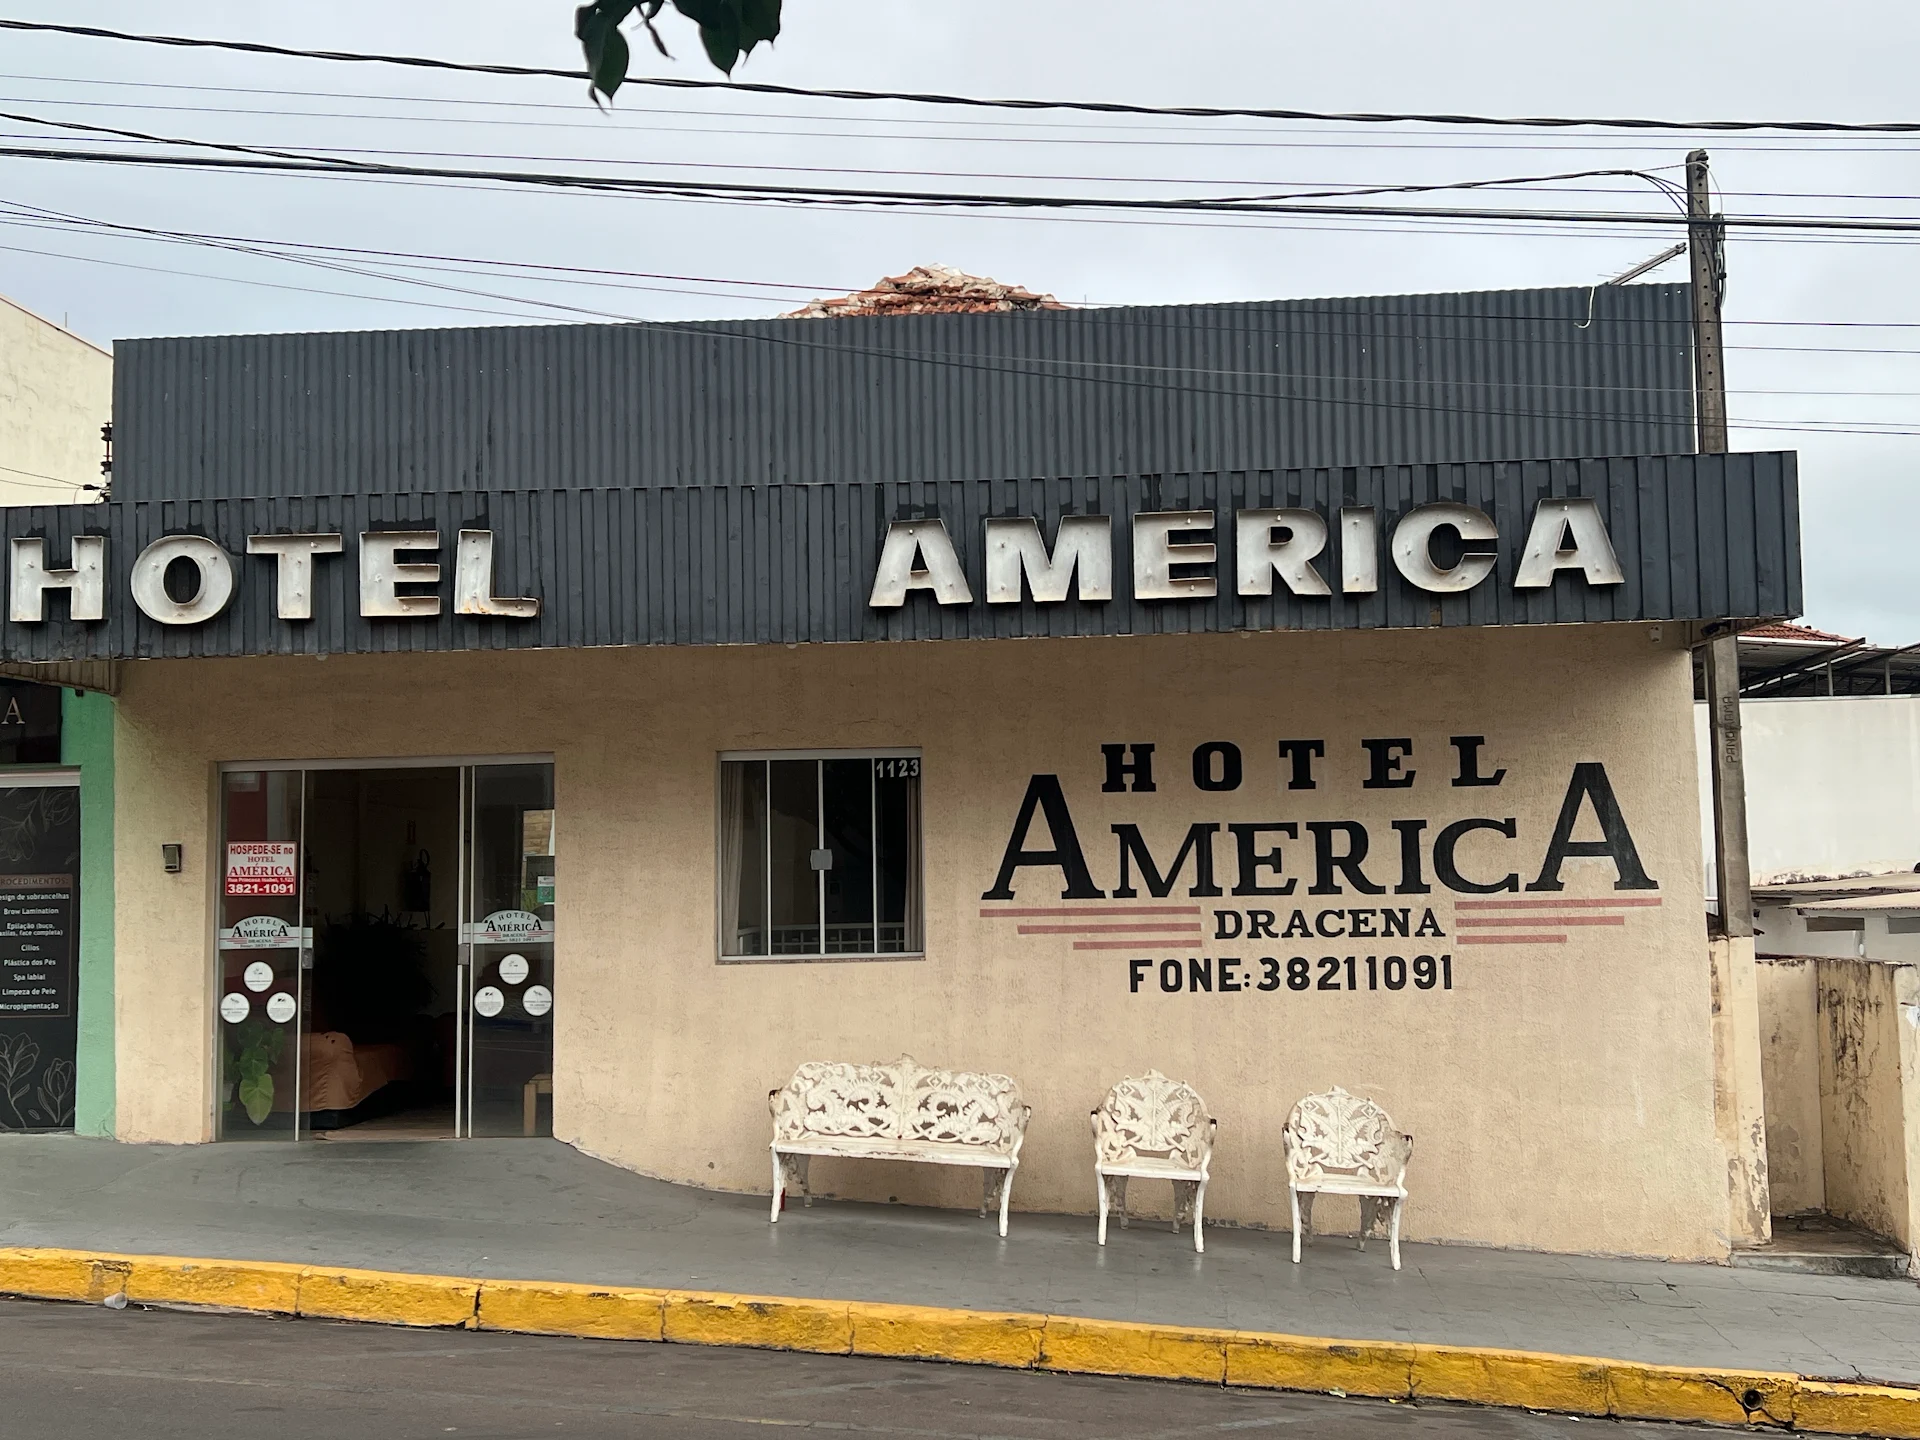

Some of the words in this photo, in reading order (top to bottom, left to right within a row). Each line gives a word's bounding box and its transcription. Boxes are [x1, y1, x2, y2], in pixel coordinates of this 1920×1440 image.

[9, 528, 540, 625] HOTEL
[868, 497, 1626, 608] AMERICA
[1722, 696, 1738, 764] PANORAMA
[876, 759, 919, 778] 1123
[1100, 735, 1507, 793] HOTEL
[981, 762, 1660, 901] AMERICA
[230, 845, 281, 854] HOSPEDE-SE
[229, 863, 292, 876] AMÉRICA
[228, 884, 293, 893] 3821-1091
[26, 892, 70, 900] sobrancelhas
[244, 917, 277, 927] HOTEL
[498, 912, 531, 921] HOTEL
[7, 922, 35, 930] Epilação
[486, 919, 542, 932] AMÉRICA
[1214, 908, 1446, 940] DRACENA
[232, 926, 288, 937] AMÉRICA
[41, 987, 56, 995] Pele
